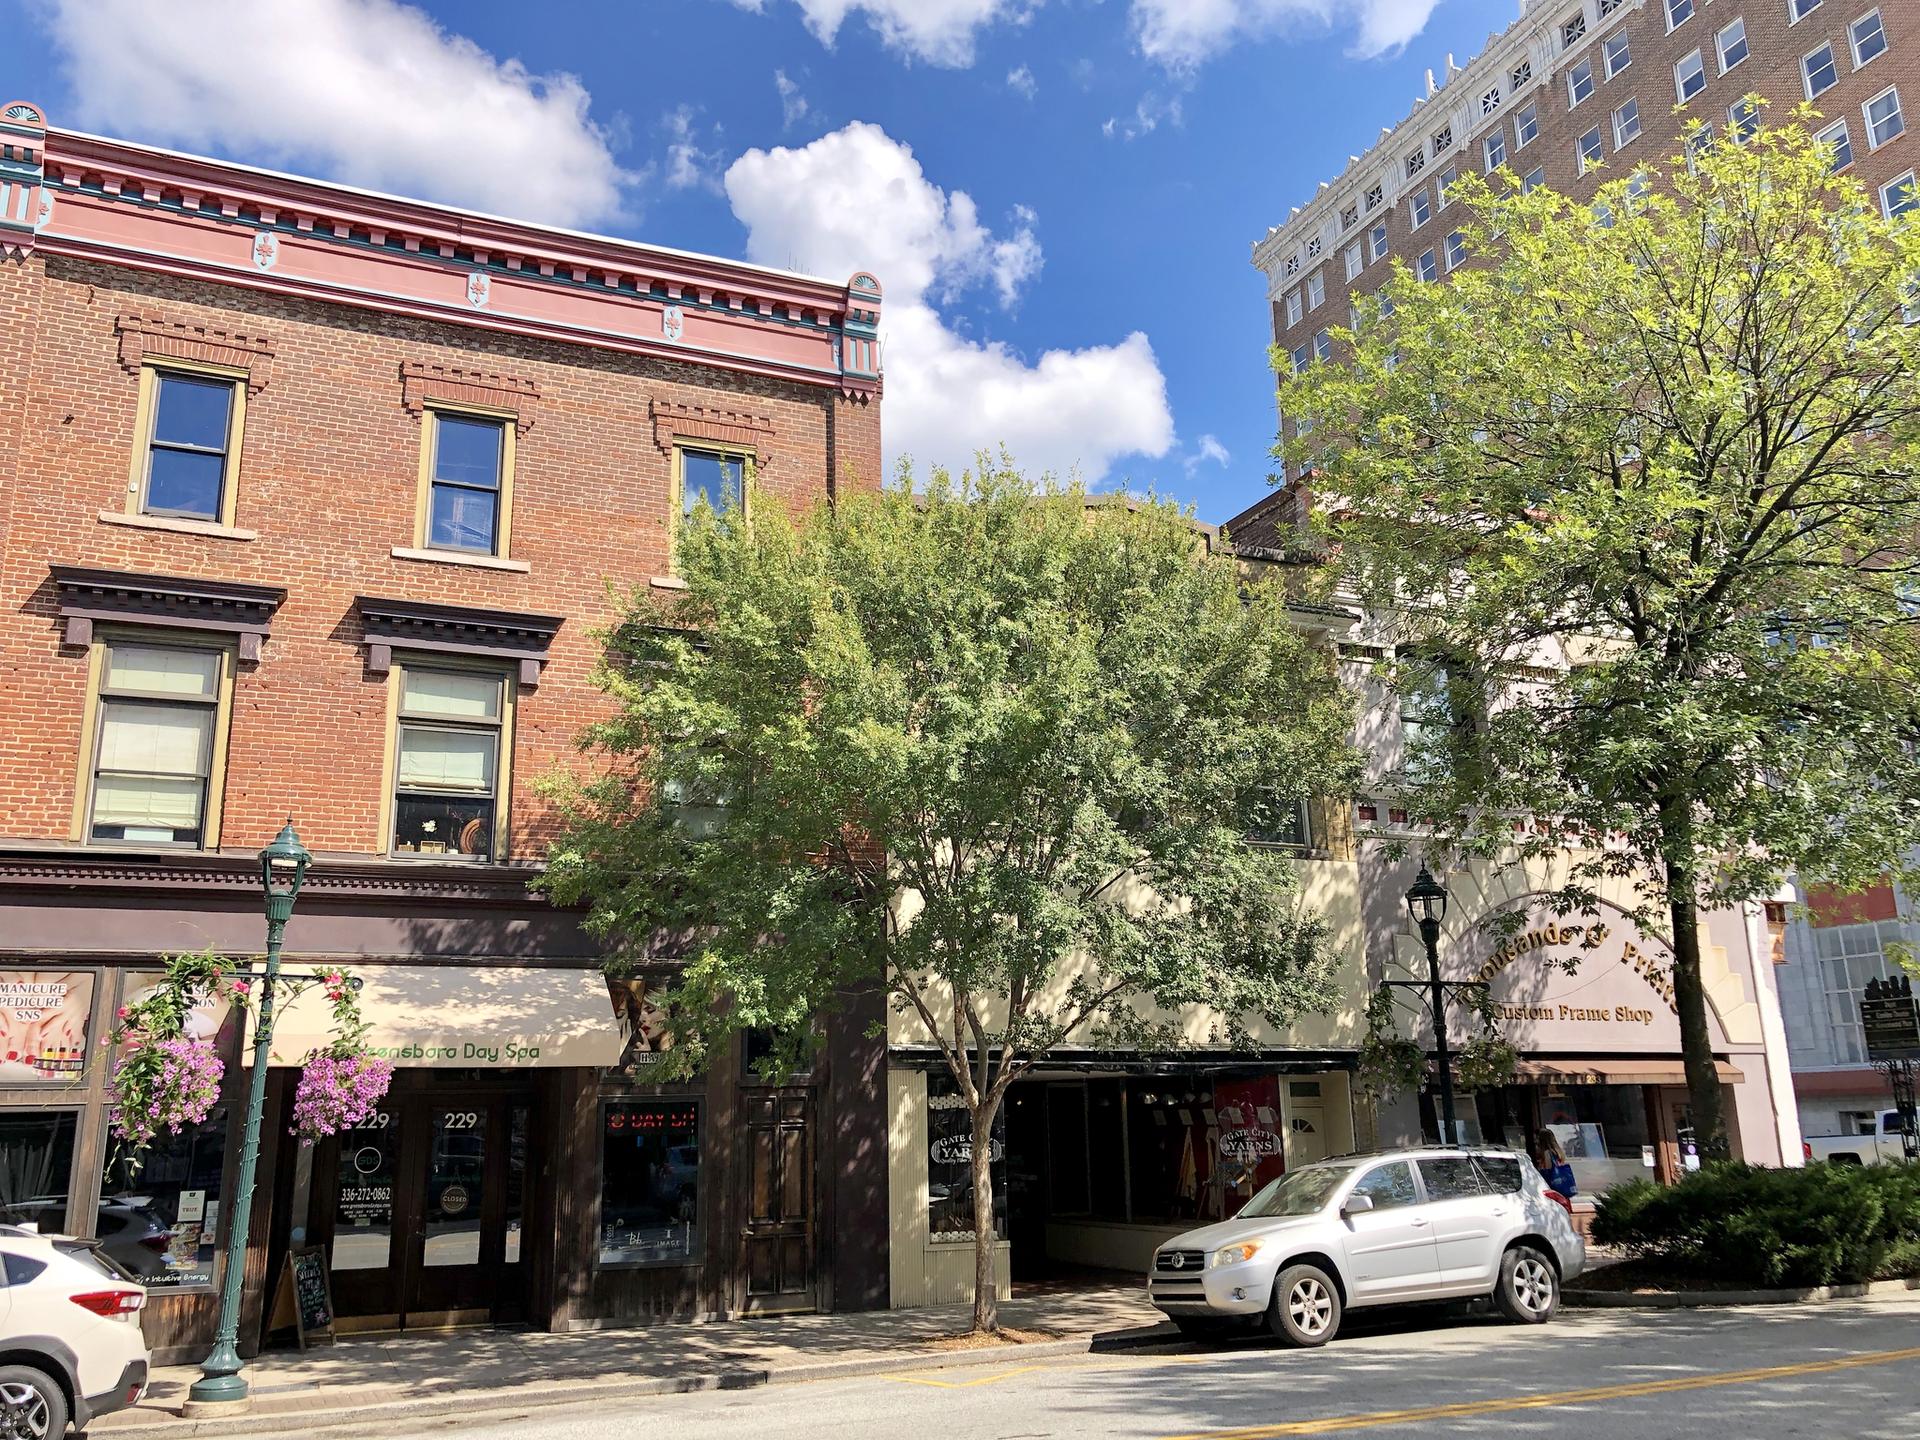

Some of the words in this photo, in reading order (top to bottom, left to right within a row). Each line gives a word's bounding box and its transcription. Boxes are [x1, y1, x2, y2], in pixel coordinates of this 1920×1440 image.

[0, 985, 66, 995] MANICURE
[0, 997, 63, 1007] PEDICURE
[16, 1011, 41, 1020] SNS
[1493, 1004, 1554, 1020] Custom
[1559, 1004, 1611, 1022] Frame
[1615, 1004, 1654, 1025] Shop
[366, 1043, 457, 1059] eensboro
[464, 1043, 499, 1062] Day
[505, 1043, 540, 1062] Spa
[356, 1113, 389, 1129] 229
[444, 1113, 478, 1129] 229
[940, 1134, 966, 1147] GATE
[1227, 1129, 1249, 1141] GATE
[1251, 1128, 1273, 1140] CITY
[1229, 1141, 1273, 1151] YARNS
[941, 1147, 992, 1159] YAR
[341, 1187, 391, 1201] 336-272-0862
[151, 1275, 181, 1283] Intuitive
[183, 1274, 209, 1282] Energy
